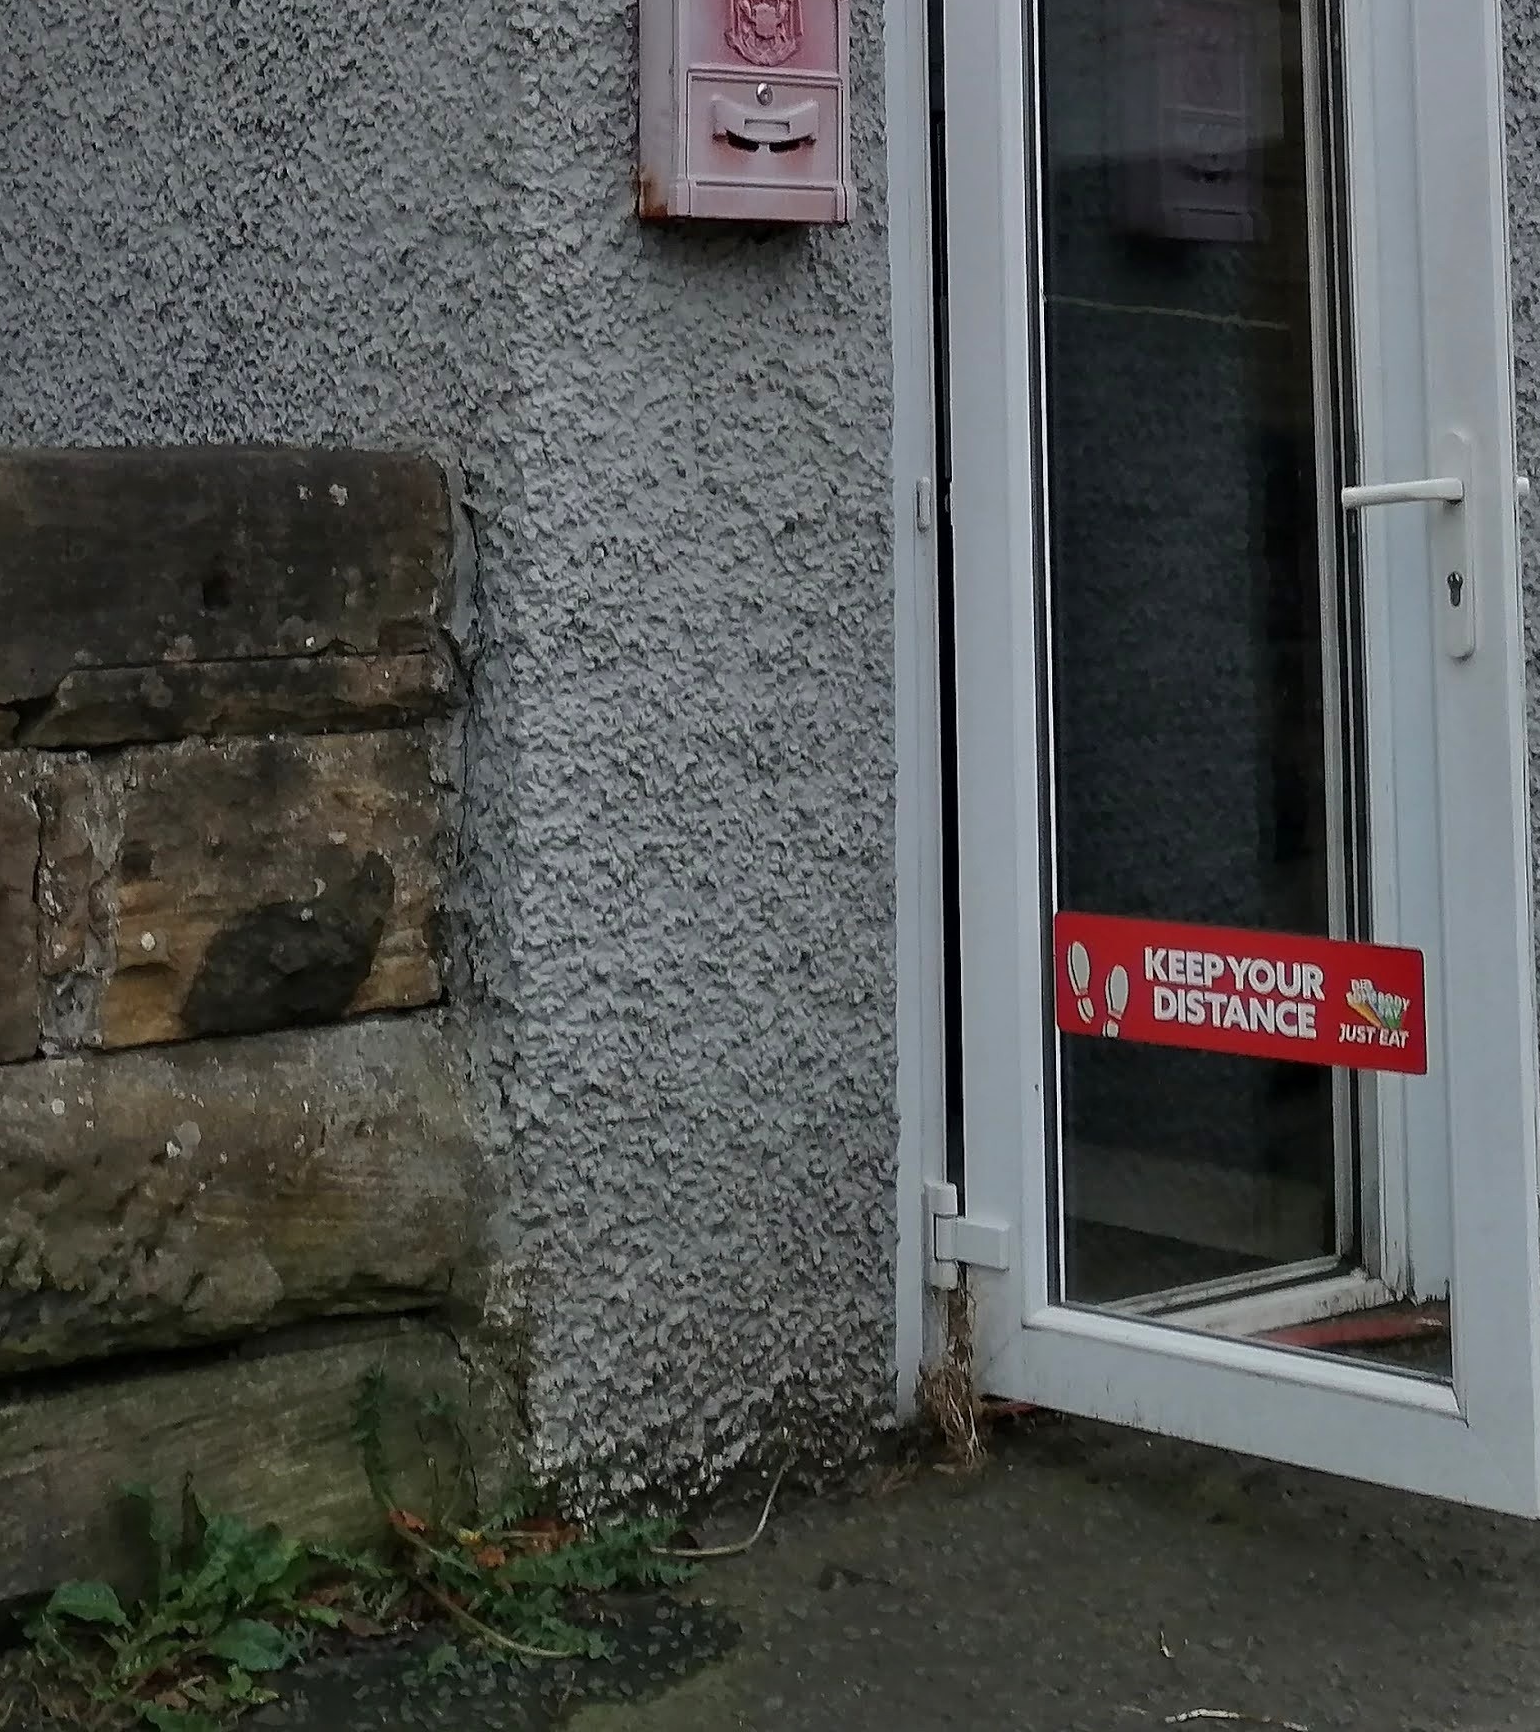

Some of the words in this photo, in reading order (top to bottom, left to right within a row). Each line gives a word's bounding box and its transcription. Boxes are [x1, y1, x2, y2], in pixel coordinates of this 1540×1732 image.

[1144, 946, 1224, 986] KEEP
[1226, 954, 1324, 1001] YOUR
[1153, 985, 1317, 1040] DISTANCE
[1339, 1022, 1376, 1045] JUST
[1379, 1027, 1409, 1048] EAT
